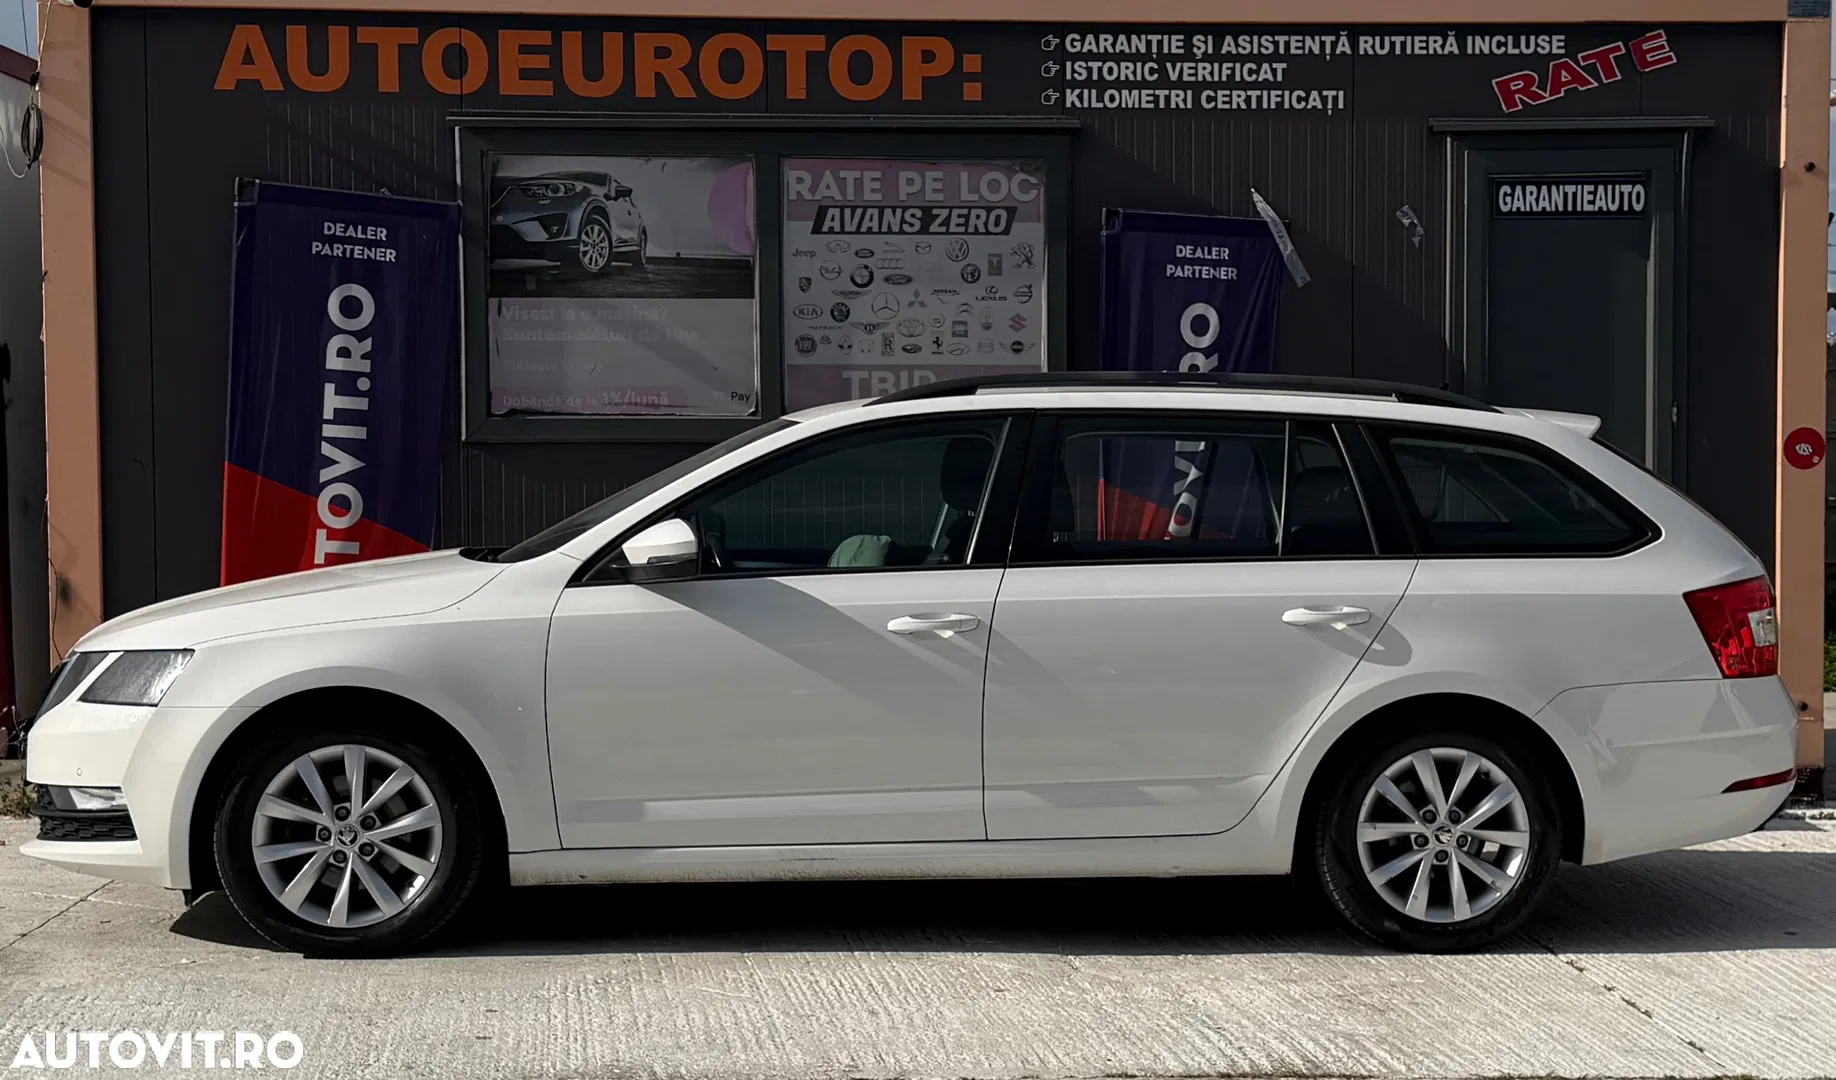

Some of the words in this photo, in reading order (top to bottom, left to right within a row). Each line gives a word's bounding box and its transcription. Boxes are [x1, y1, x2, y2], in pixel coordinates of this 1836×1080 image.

[1065, 33, 1185, 59] GARANȚIE
[1359, 31, 1459, 55] RUTIERĂ
[1467, 35, 1566, 55] INCLUSE
[213, 25, 982, 101] AUTOEUROTOP:
[1065, 61, 1159, 81] ISTORIC
[1166, 62, 1287, 82] VERIFICAT
[1492, 29, 1677, 113] RATE
[1065, 88, 1193, 109] KILOMETRI
[1200, 90, 1344, 115] CERTIFICAȚI
[788, 170, 882, 201] RATE
[899, 171, 945, 202] PE
[960, 171, 1039, 202] LOC
[1498, 184, 1645, 212] GARANTIEAUTO
[323, 222, 387, 241] DEALER
[821, 207, 922, 233] AVANS
[929, 208, 1008, 233] ZERO
[311, 241, 397, 262] PARTENER
[792, 248, 816, 259] Jeep
[1175, 245, 1229, 260] DEALER
[1166, 264, 1238, 280] PARTENER
[730, 391, 751, 403] Pay
[313, 283, 376, 565] TOVIT.RO
